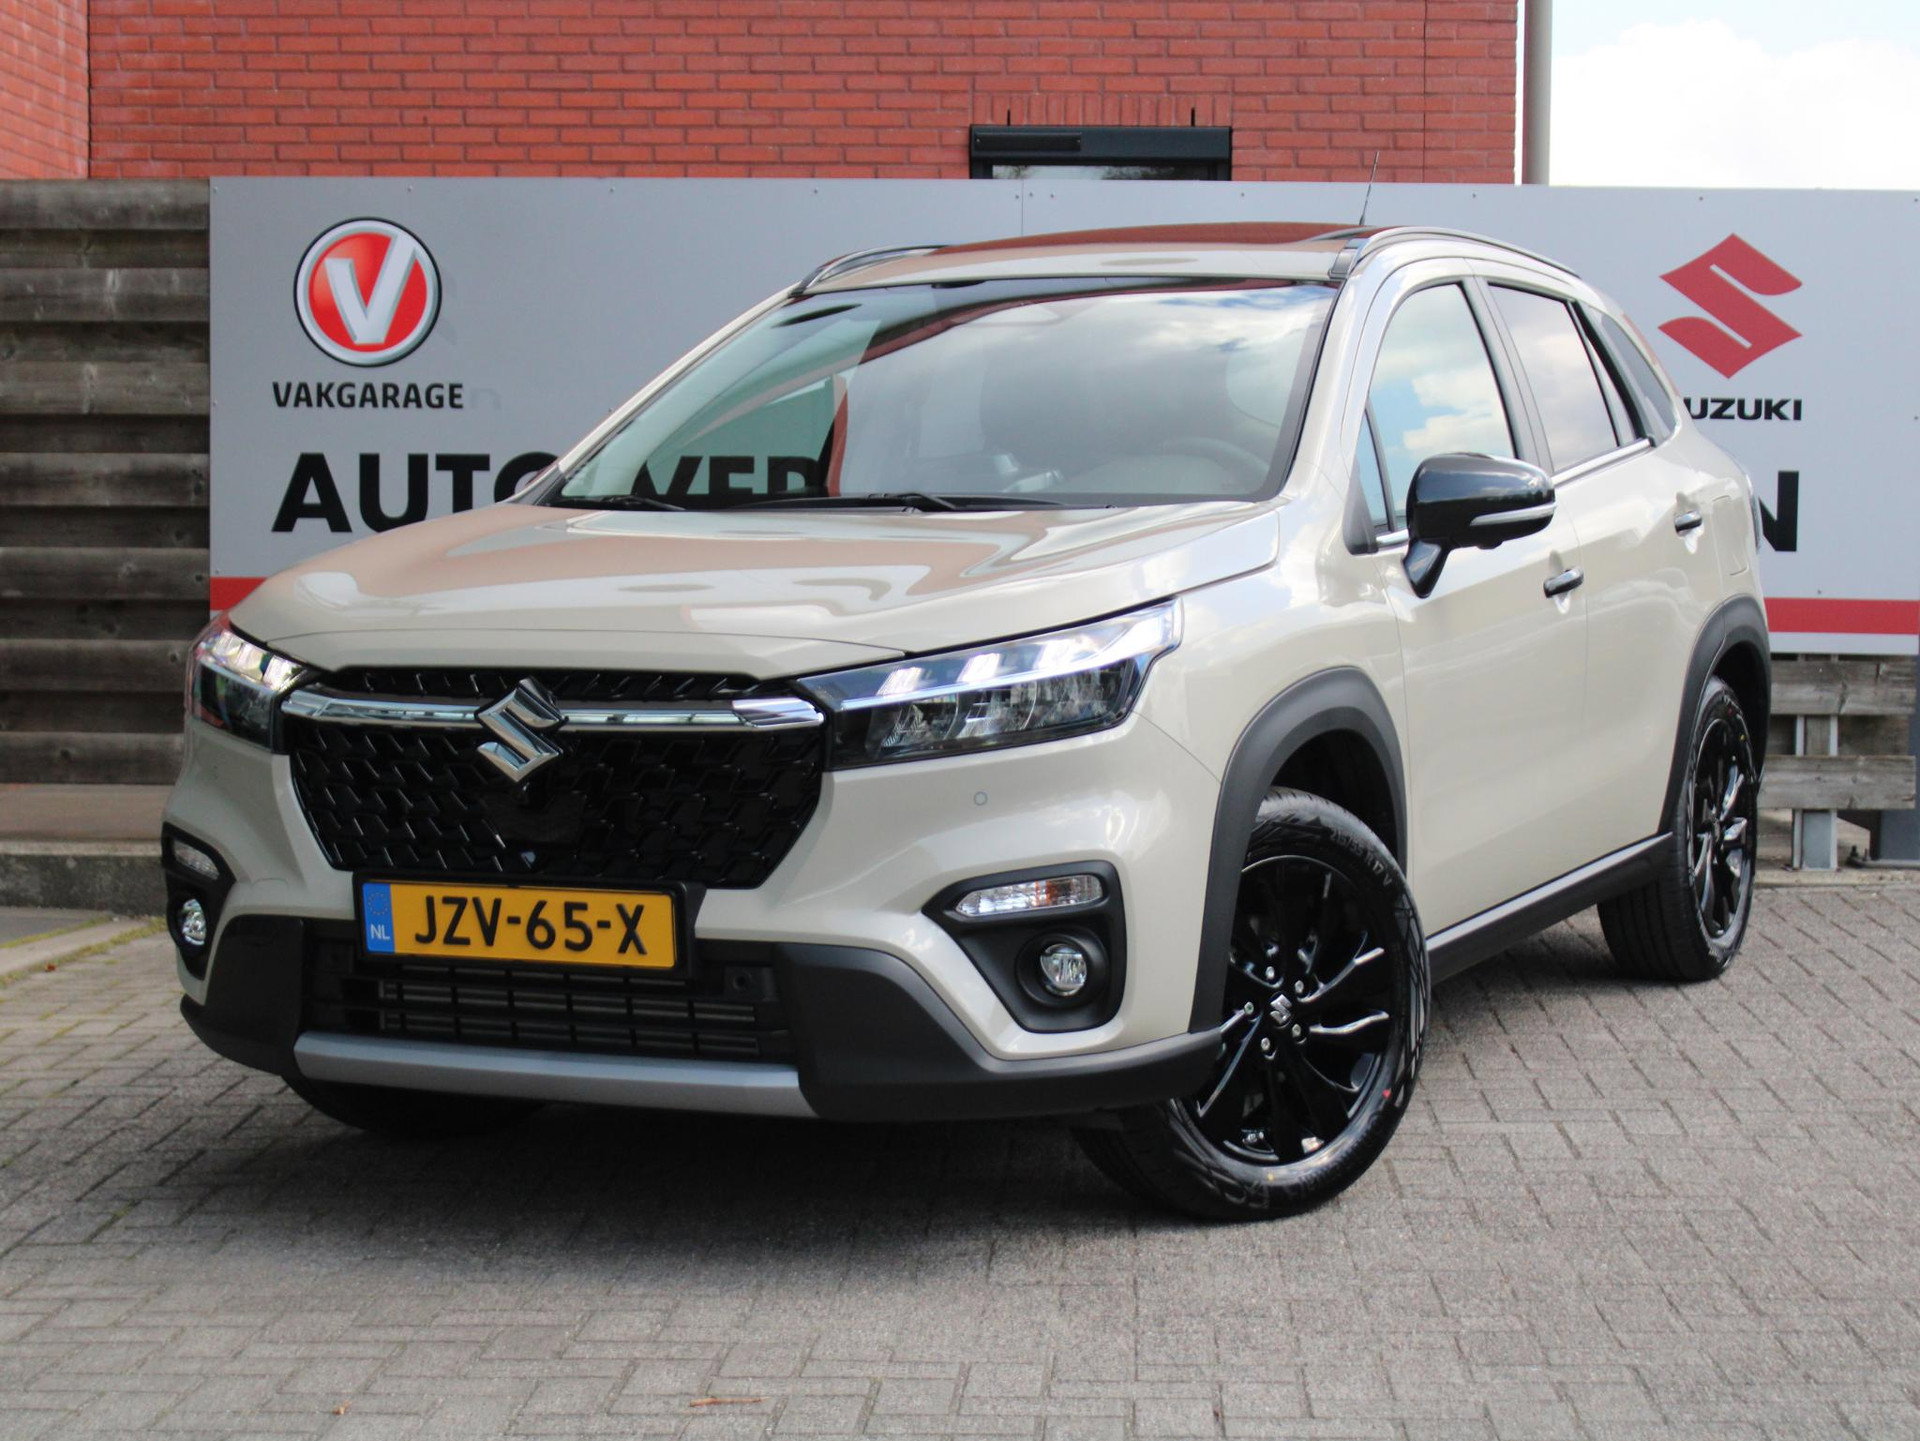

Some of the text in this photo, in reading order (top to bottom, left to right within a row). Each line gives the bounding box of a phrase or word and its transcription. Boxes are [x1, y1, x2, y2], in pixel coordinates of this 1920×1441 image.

[272, 381, 464, 409] VAKGARAGE
[1683, 397, 1802, 421] UZUKI
[369, 895, 648, 955] NL JZV-65-X
